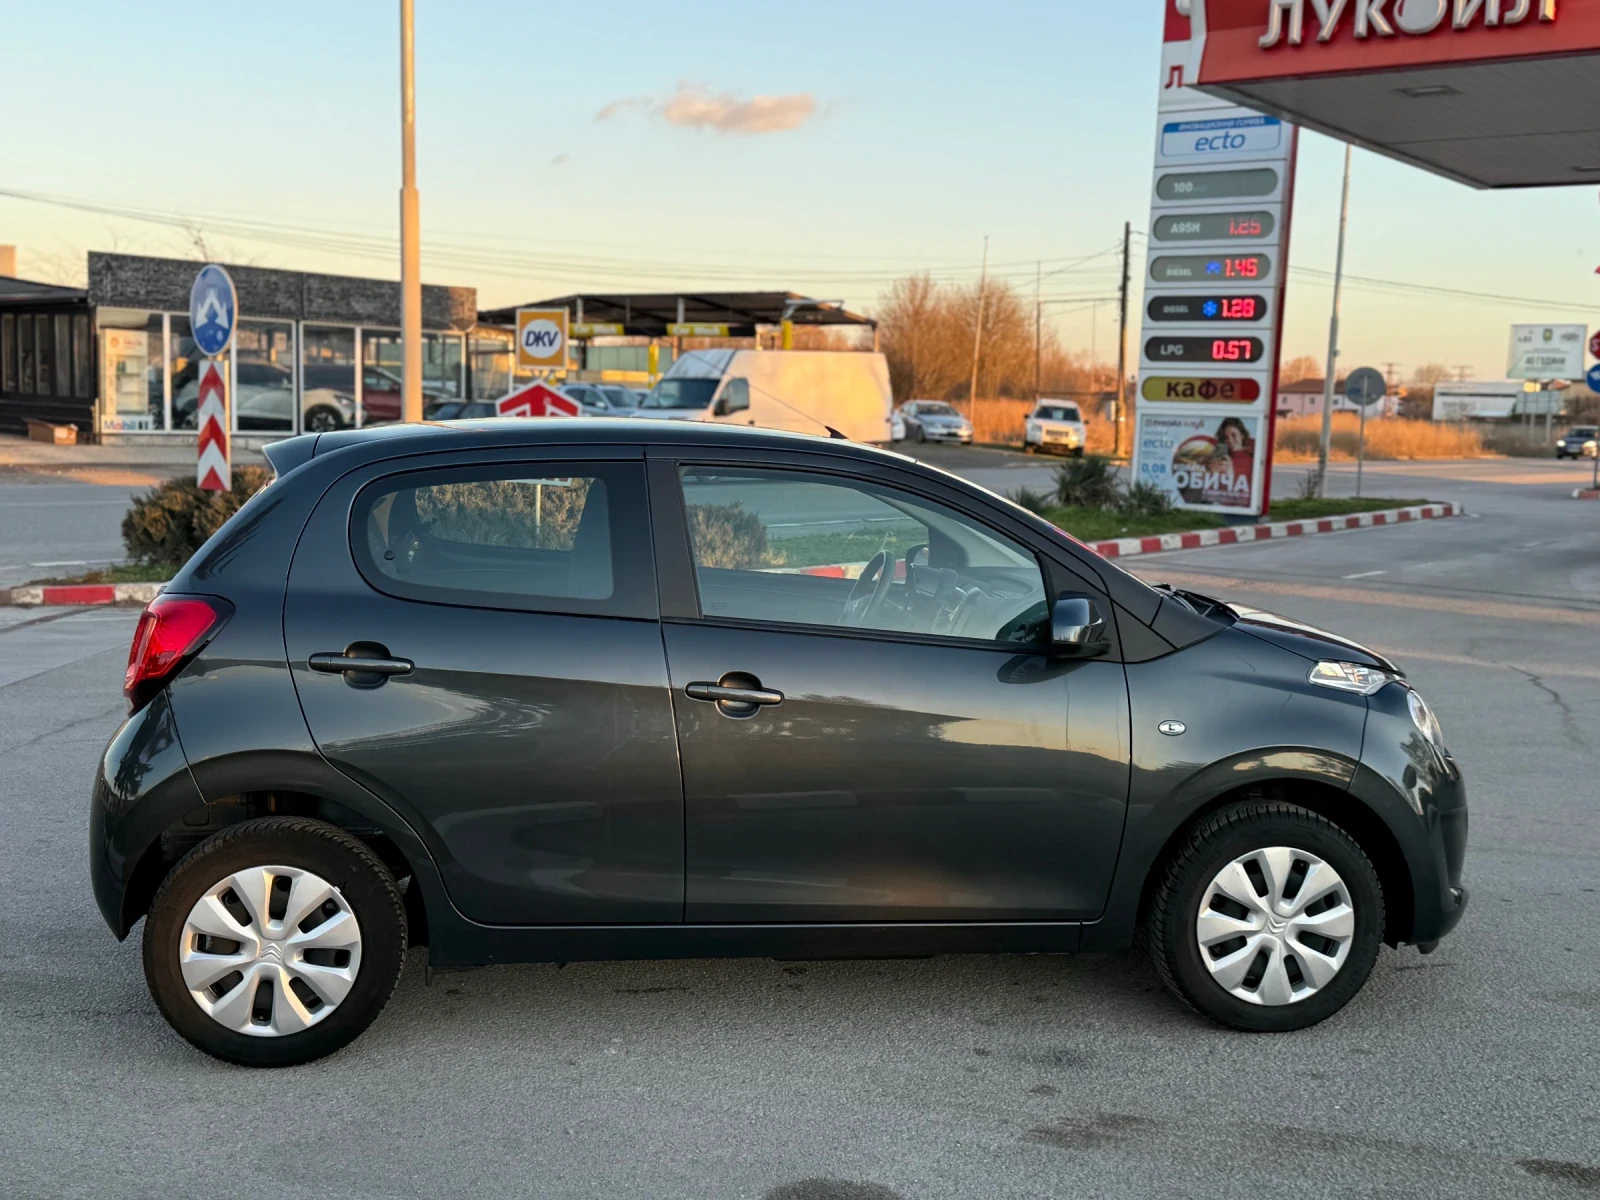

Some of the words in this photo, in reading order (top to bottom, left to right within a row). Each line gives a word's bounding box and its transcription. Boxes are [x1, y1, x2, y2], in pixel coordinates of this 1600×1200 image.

[1195, 131, 1246, 151] ecto
[1173, 182, 1193, 193] 100
[1166, 268, 1192, 277] DIESEL
[1225, 258, 1258, 277] 1.45
[1163, 304, 1189, 314] DIESEL
[1221, 298, 1255, 318] 1.28
[525, 330, 559, 348] DKV
[1160, 344, 1184, 356] LPG
[1212, 340, 1252, 360] 0.57
[1166, 380, 1235, 400] кафе
[104, 419, 137, 431] Mobil
[1143, 439, 1174, 449] ecto
[1174, 470, 1249, 492] ОБИЧА
